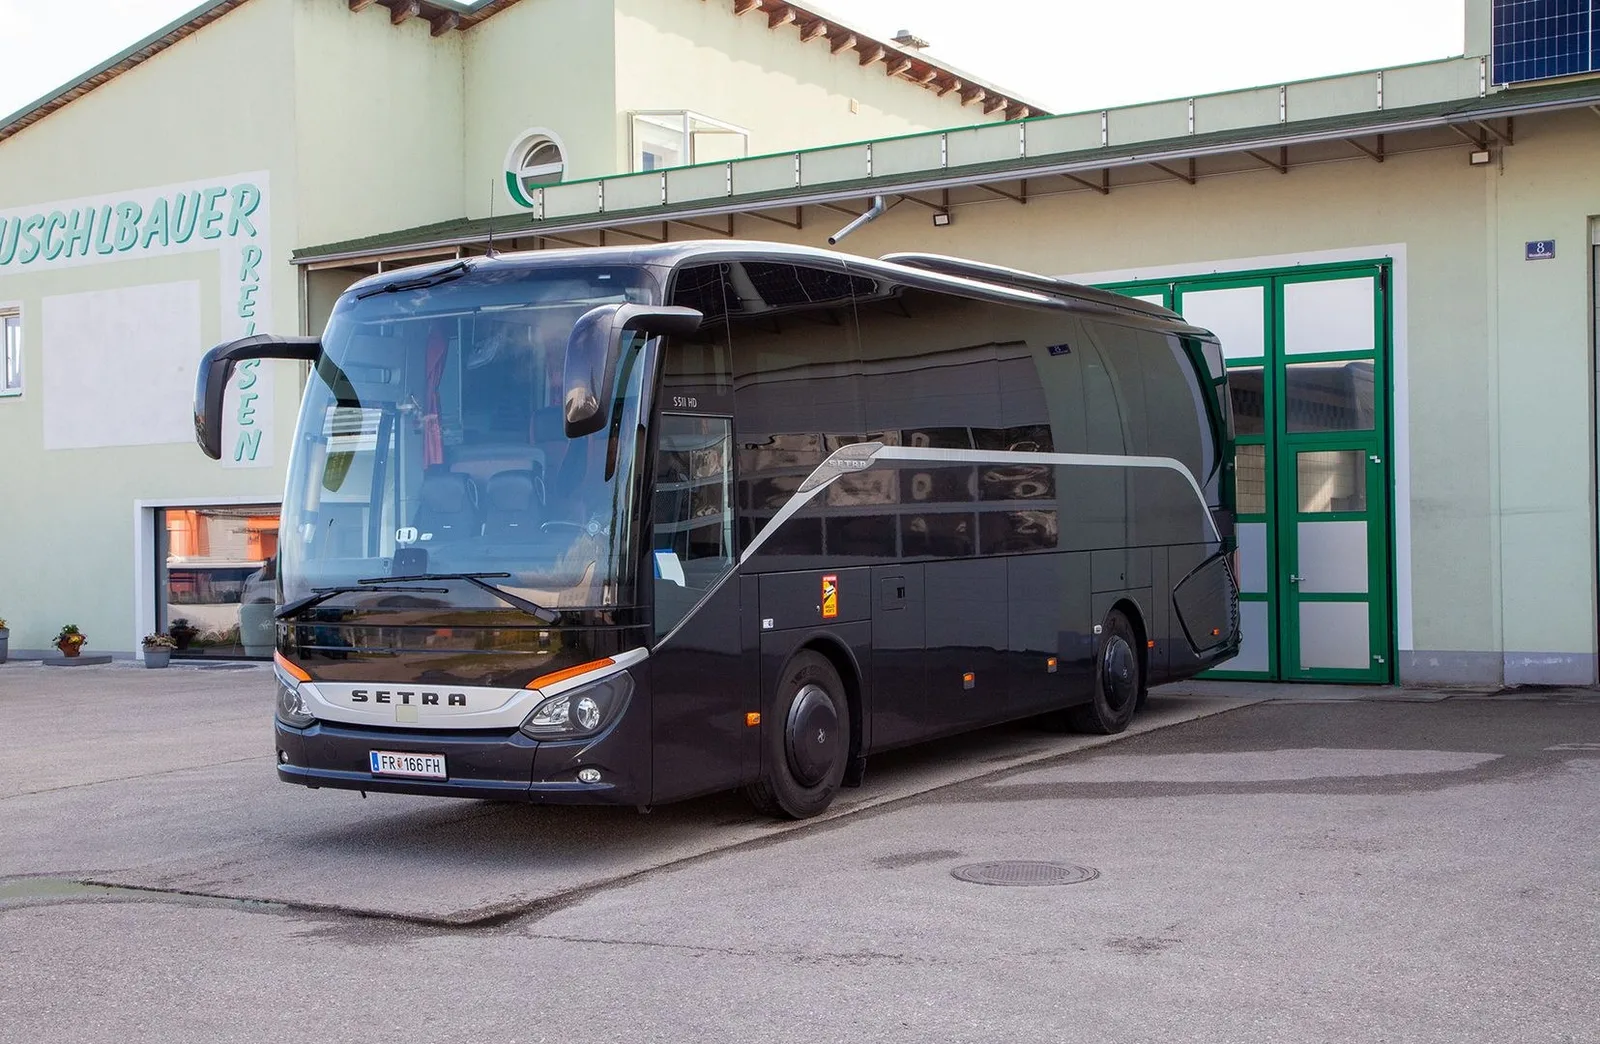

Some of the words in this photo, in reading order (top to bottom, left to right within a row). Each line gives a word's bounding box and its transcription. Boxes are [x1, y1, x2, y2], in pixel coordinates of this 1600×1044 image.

[0, 183, 261, 265] USCHLBAUER
[1537, 242, 1545, 253] 8
[351, 690, 467, 706] SETRA
[381, 756, 395, 770] FR
[404, 757, 423, 772] 166
[425, 759, 440, 773] FH
